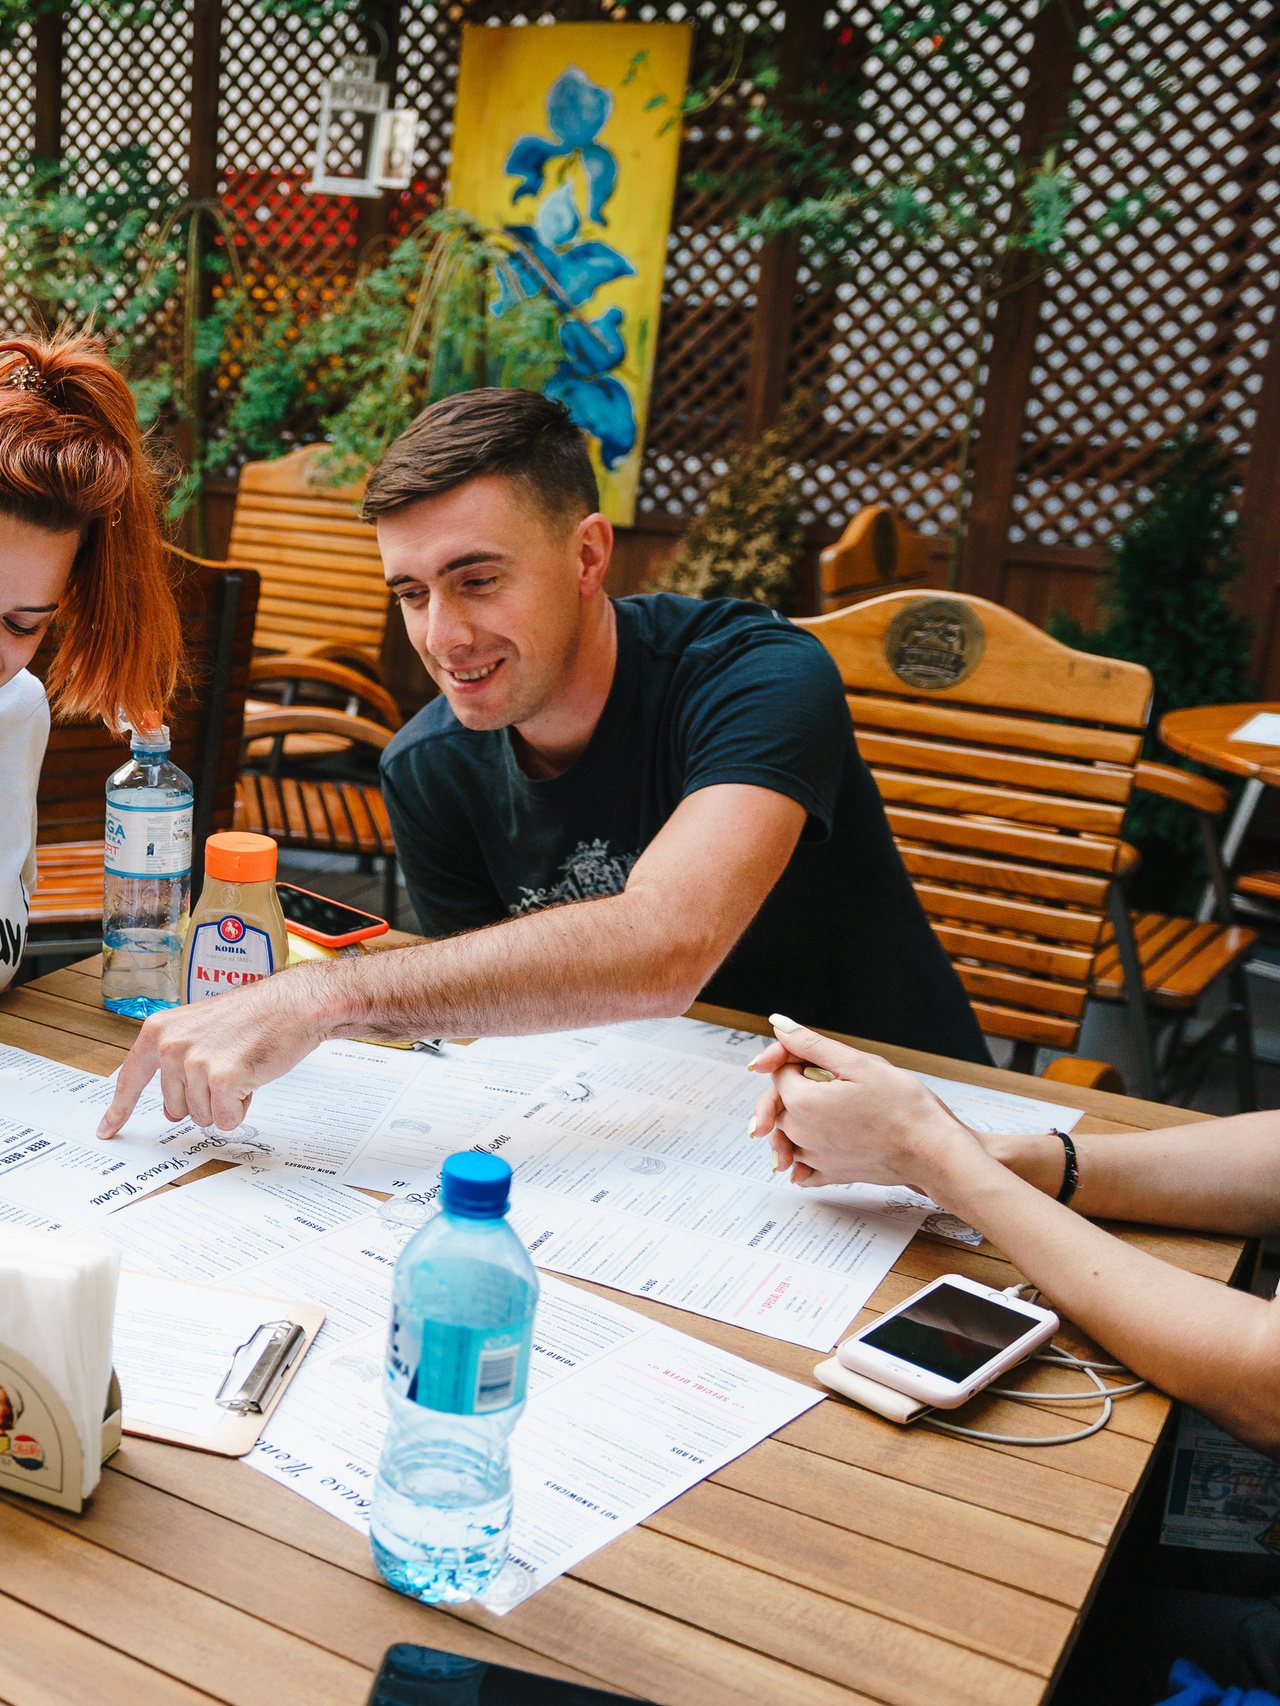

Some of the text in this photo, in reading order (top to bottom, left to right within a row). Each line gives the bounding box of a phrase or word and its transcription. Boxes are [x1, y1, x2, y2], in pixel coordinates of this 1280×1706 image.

[25, 1140, 51, 1152] BEER
[0, 1152, 26, 1164] BEER
[90, 1135, 230, 1206] Beer House Menu
[284, 1162, 316, 1171] COURSES
[294, 1216, 326, 1232] DESSERTS
[774, 1282, 791, 1294] OFFER
[546, 1352, 576, 1367] POTATO
[662, 1370, 730, 1402] SPECIAL OFFER
[670, 1447, 704, 1464] SALADS
[345, 1462, 372, 1478] PASTA
[544, 1480, 619, 1520] HOT SANDWICHES
